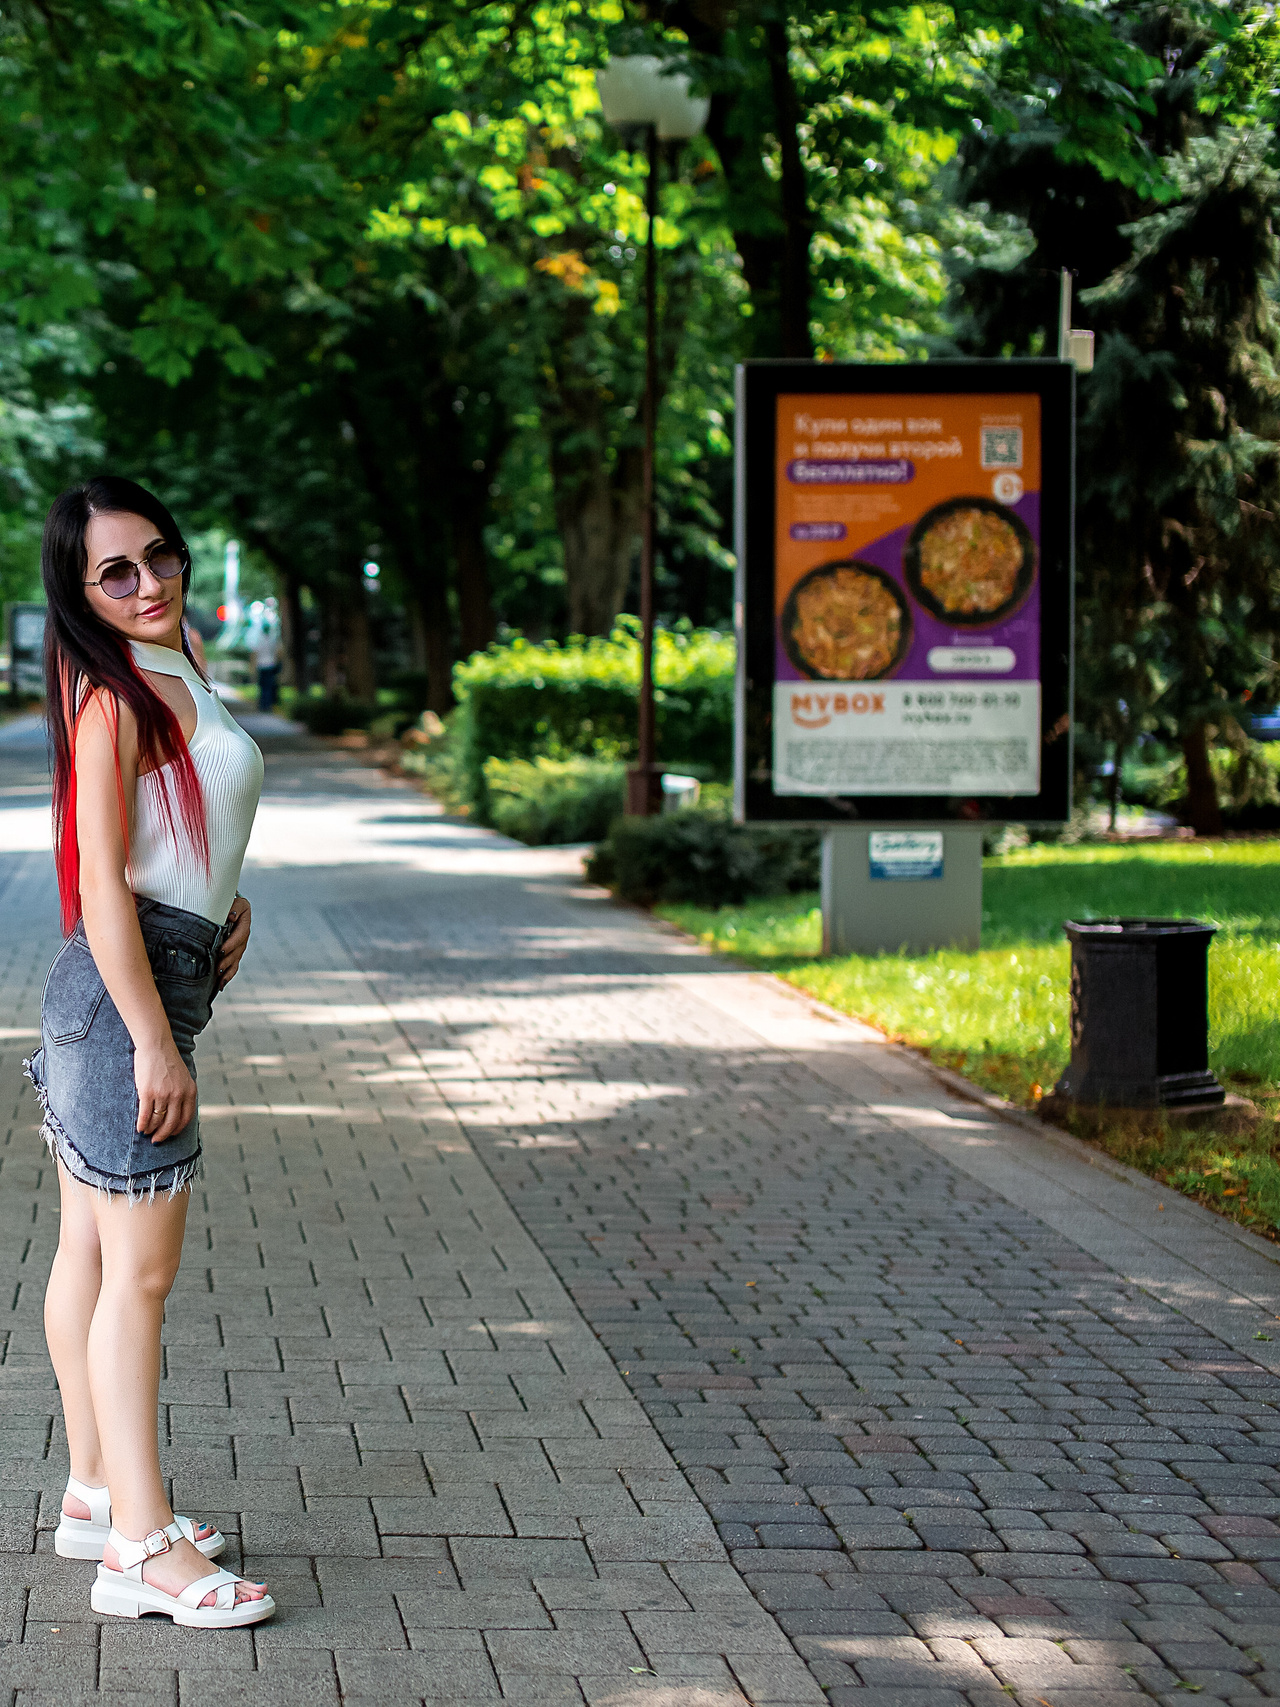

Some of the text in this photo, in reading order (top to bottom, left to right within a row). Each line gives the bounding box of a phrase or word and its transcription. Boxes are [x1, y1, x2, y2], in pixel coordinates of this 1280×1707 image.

[794, 414, 847, 437] Купи
[851, 418, 903, 434] один
[811, 442, 886, 459] получи
[889, 437, 963, 458] второй
[791, 693, 885, 715] MYBOX
